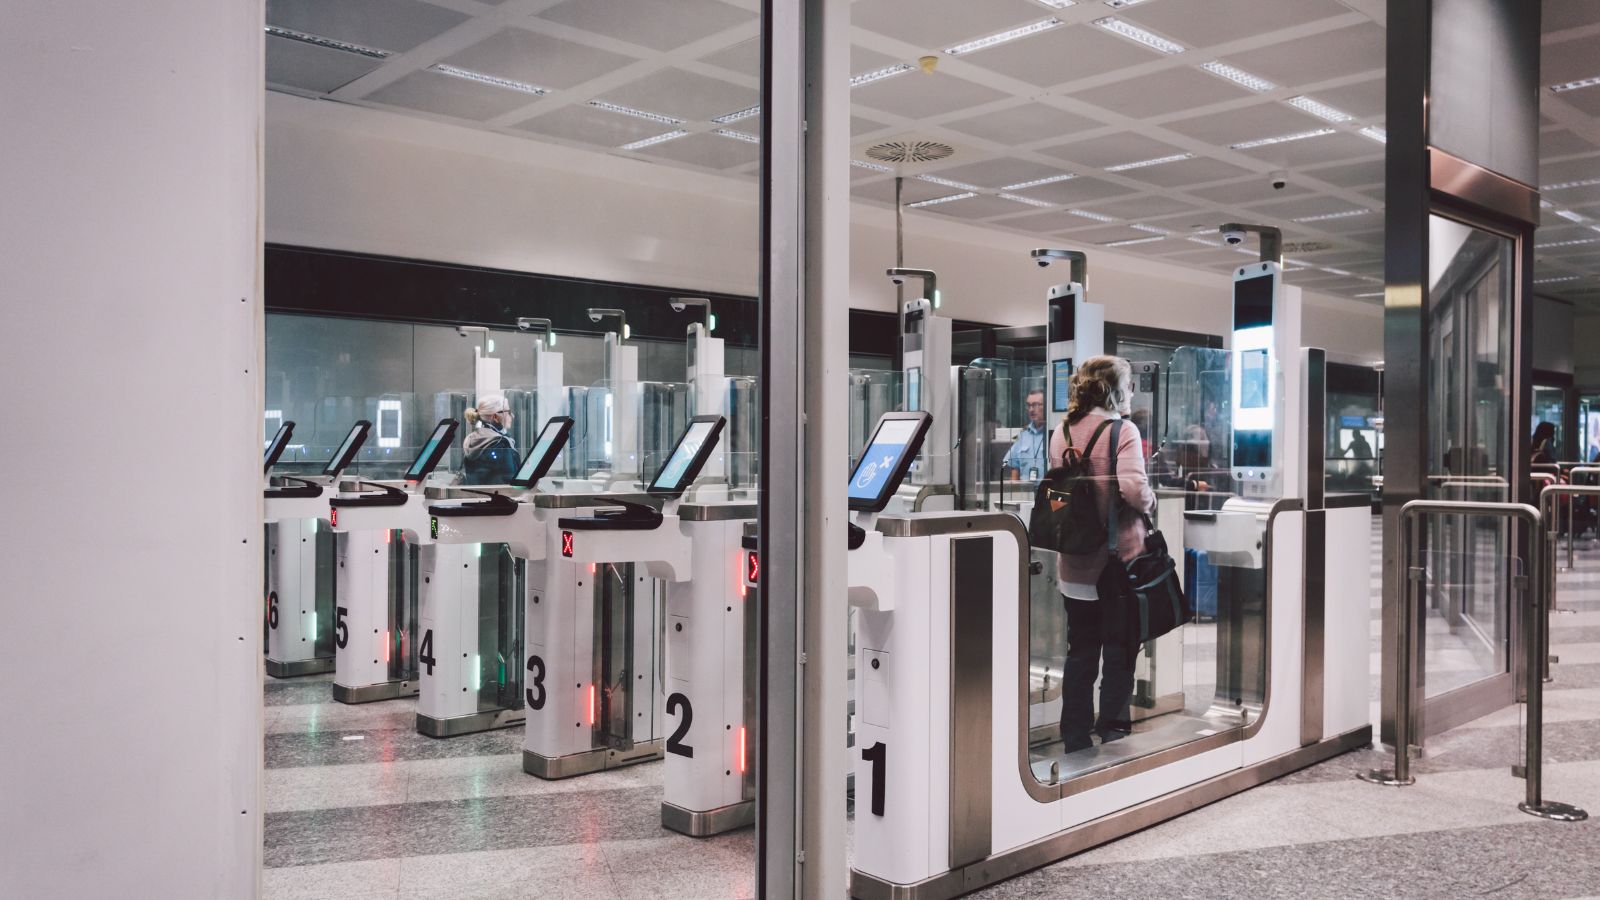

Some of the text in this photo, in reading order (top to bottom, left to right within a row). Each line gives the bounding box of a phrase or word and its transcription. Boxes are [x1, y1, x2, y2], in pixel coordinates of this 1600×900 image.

[268, 591, 279, 630] 6
[336, 606, 349, 650] 5
[419, 629, 436, 676] 4
[526, 655, 547, 711] 3
[666, 692, 694, 759] 2
[862, 741, 887, 817] 1
